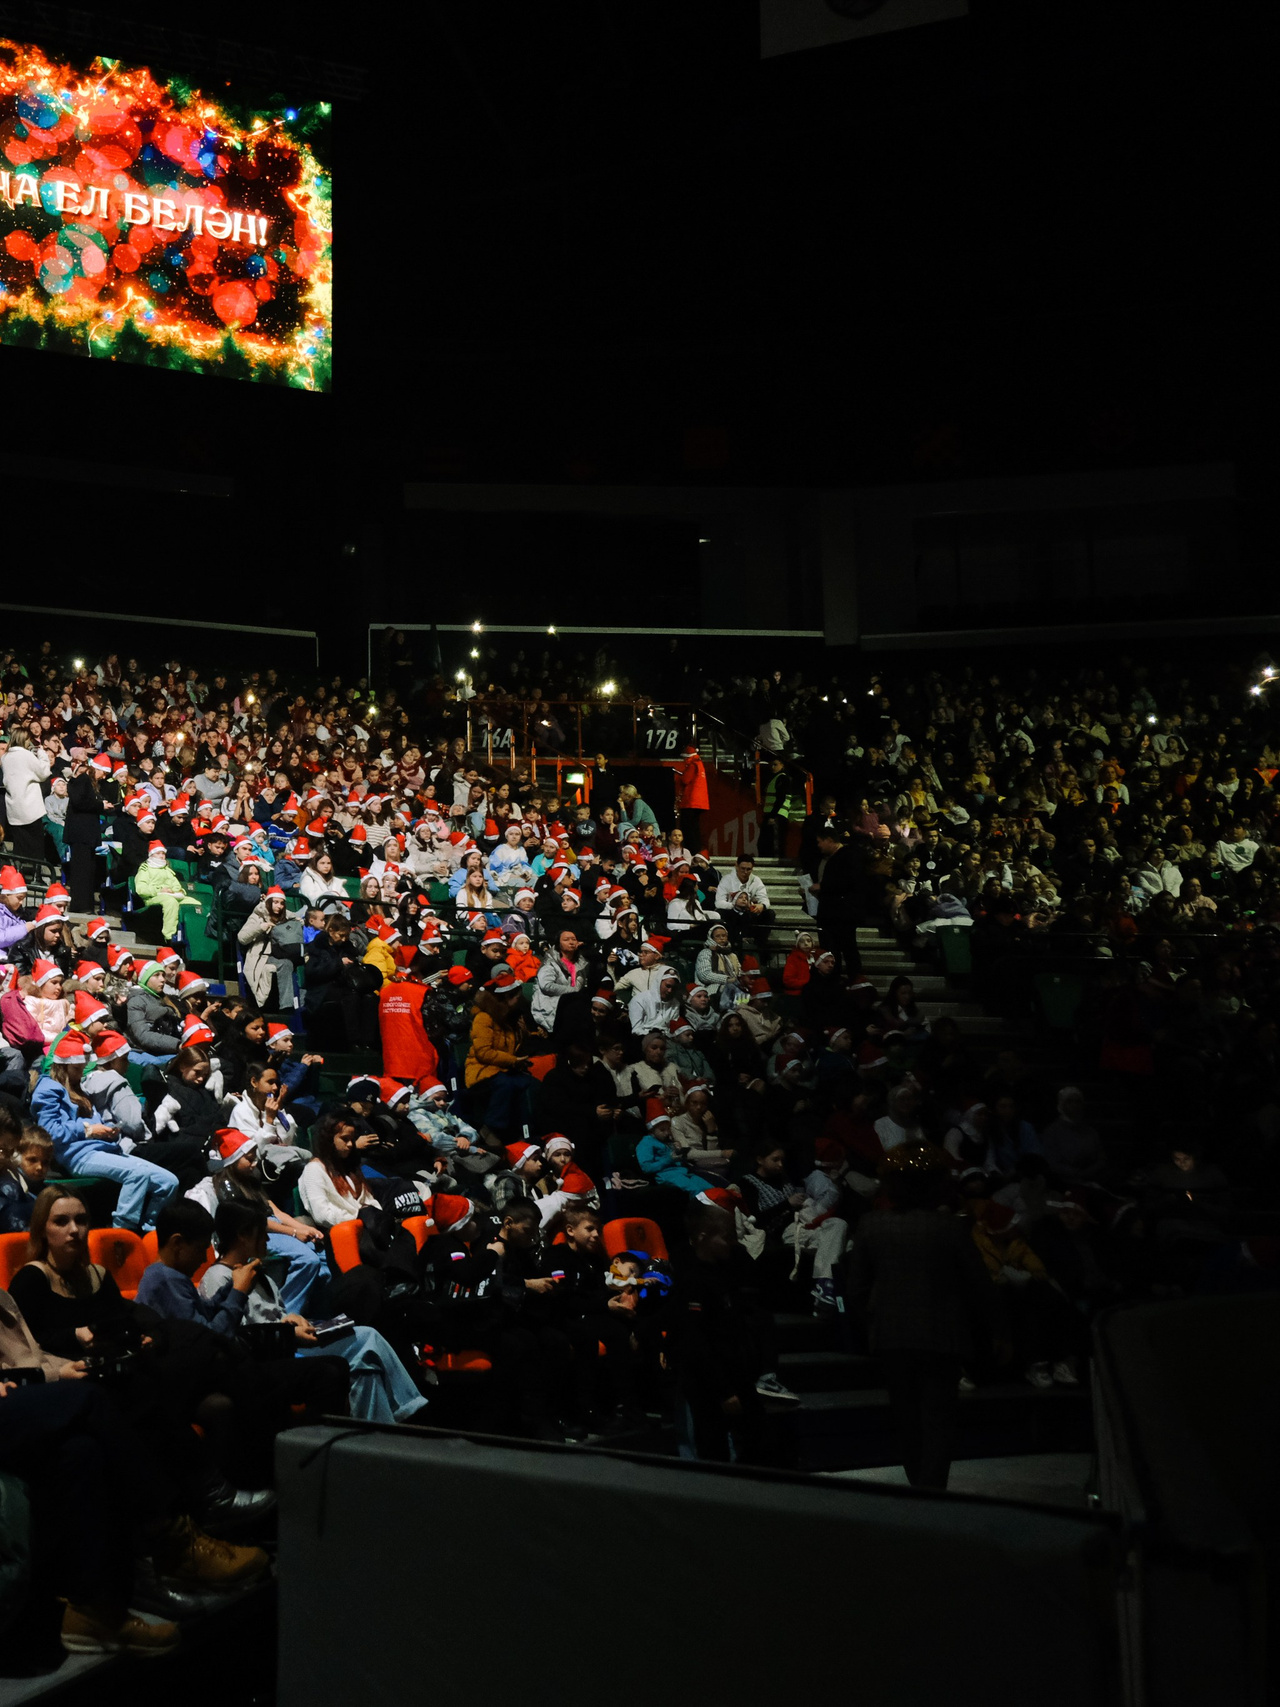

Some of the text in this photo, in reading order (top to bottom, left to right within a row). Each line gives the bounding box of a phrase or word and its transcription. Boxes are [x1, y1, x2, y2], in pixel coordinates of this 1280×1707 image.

[54, 180, 109, 218] ЕЛ
[123, 192, 267, 247] БЕЛӘН!
[646, 729, 679, 750] 17B
